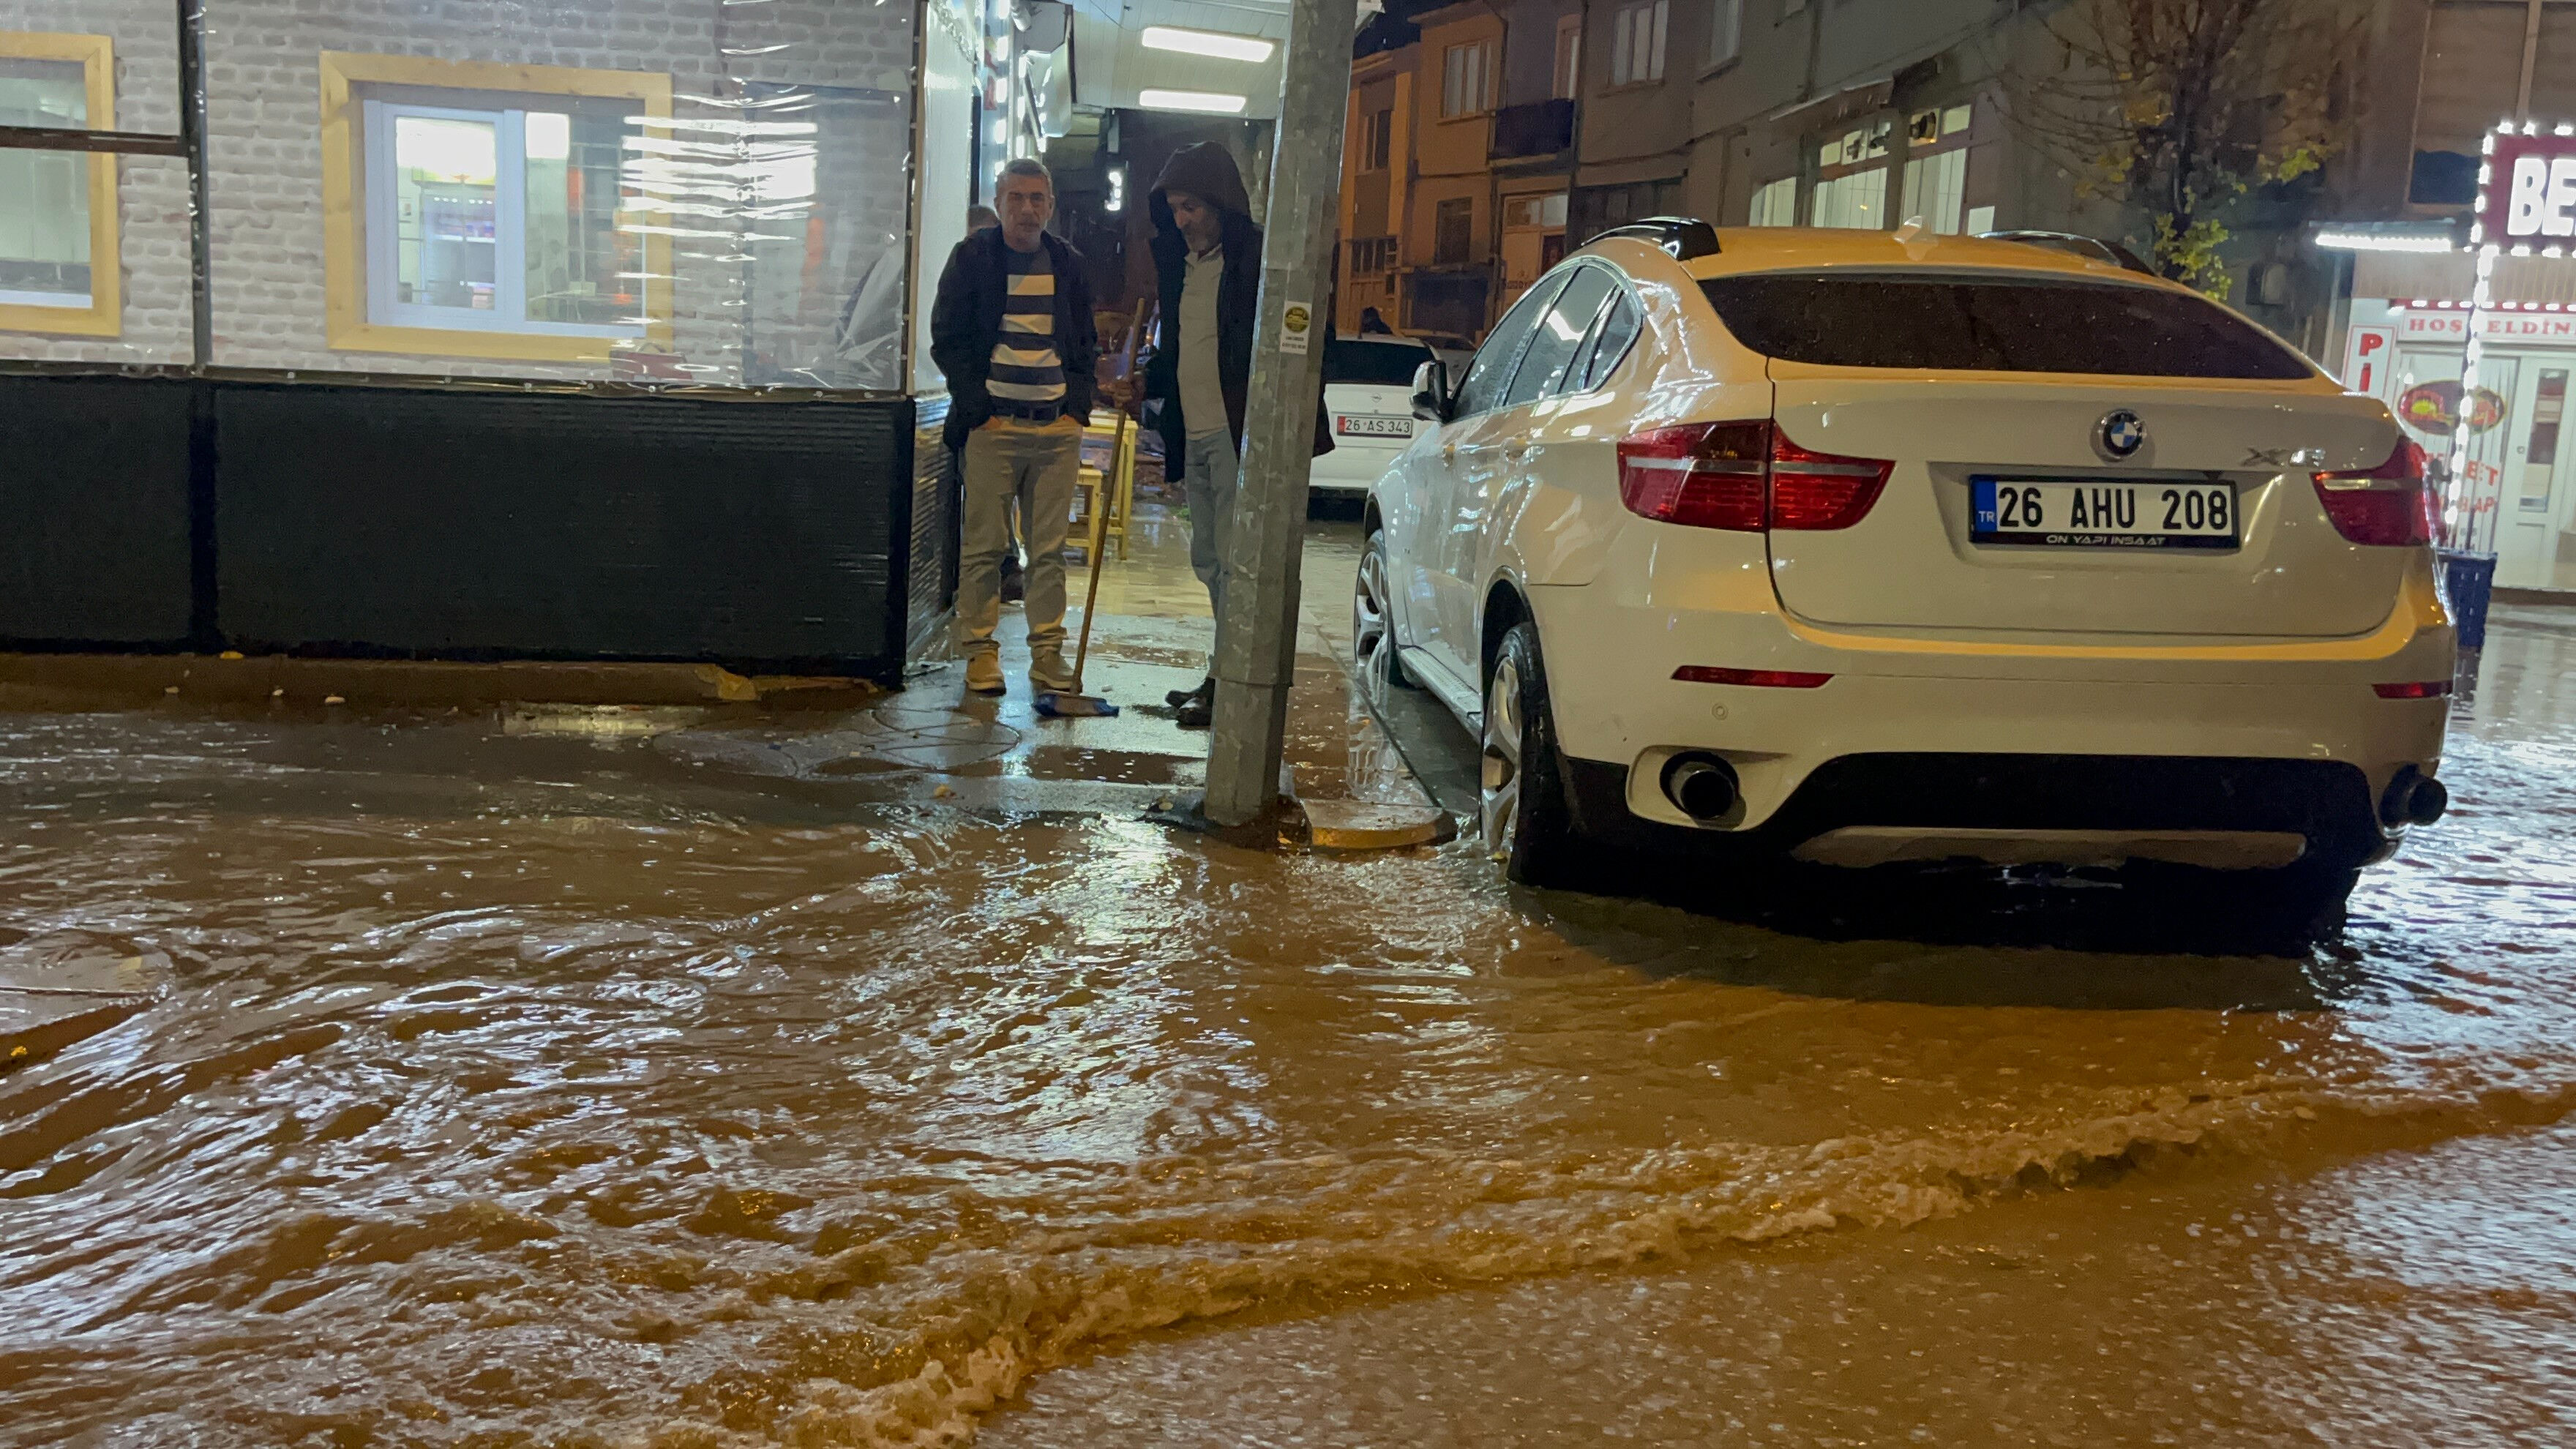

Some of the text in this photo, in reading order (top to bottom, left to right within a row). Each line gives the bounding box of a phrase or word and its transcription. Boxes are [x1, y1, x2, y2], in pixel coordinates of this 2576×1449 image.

[2507, 158, 2575, 236] BE
[2409, 318, 2575, 335] HOŞ ELDİN
[1346, 419, 1410, 433] 26 AS 343
[1999, 487, 2228, 531] 26 AHU 208
[1979, 512, 1996, 523] TR
[2046, 534, 2068, 544] ON
